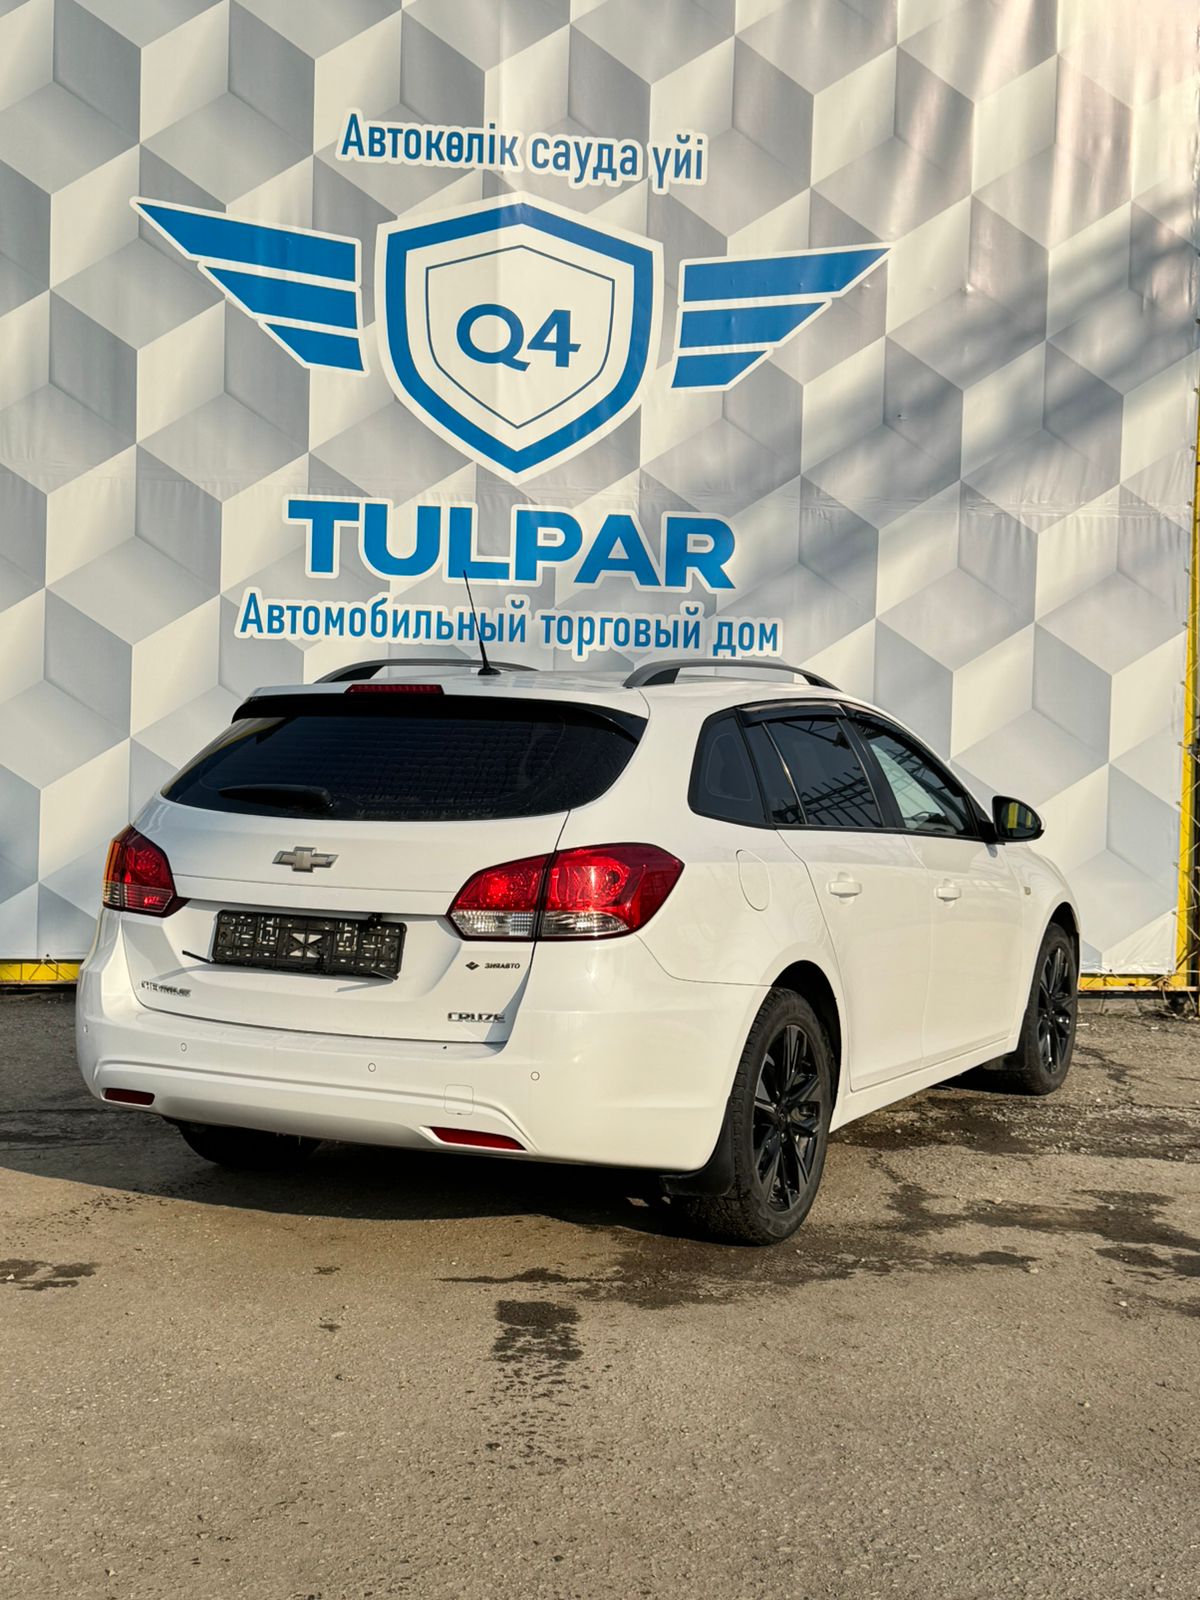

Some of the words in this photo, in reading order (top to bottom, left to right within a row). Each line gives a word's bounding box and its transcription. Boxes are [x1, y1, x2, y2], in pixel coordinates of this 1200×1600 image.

[341, 113, 519, 167] Автокөлік
[531, 137, 638, 184] сауда
[652, 134, 704, 189] үйі
[456, 303, 582, 372] Q4
[288, 499, 736, 590] TULPAR
[240, 592, 527, 644] Автомобильный
[541, 606, 701, 657] торговый
[713, 621, 779, 658] дом
[447, 1012, 506, 1023] CRUZE
